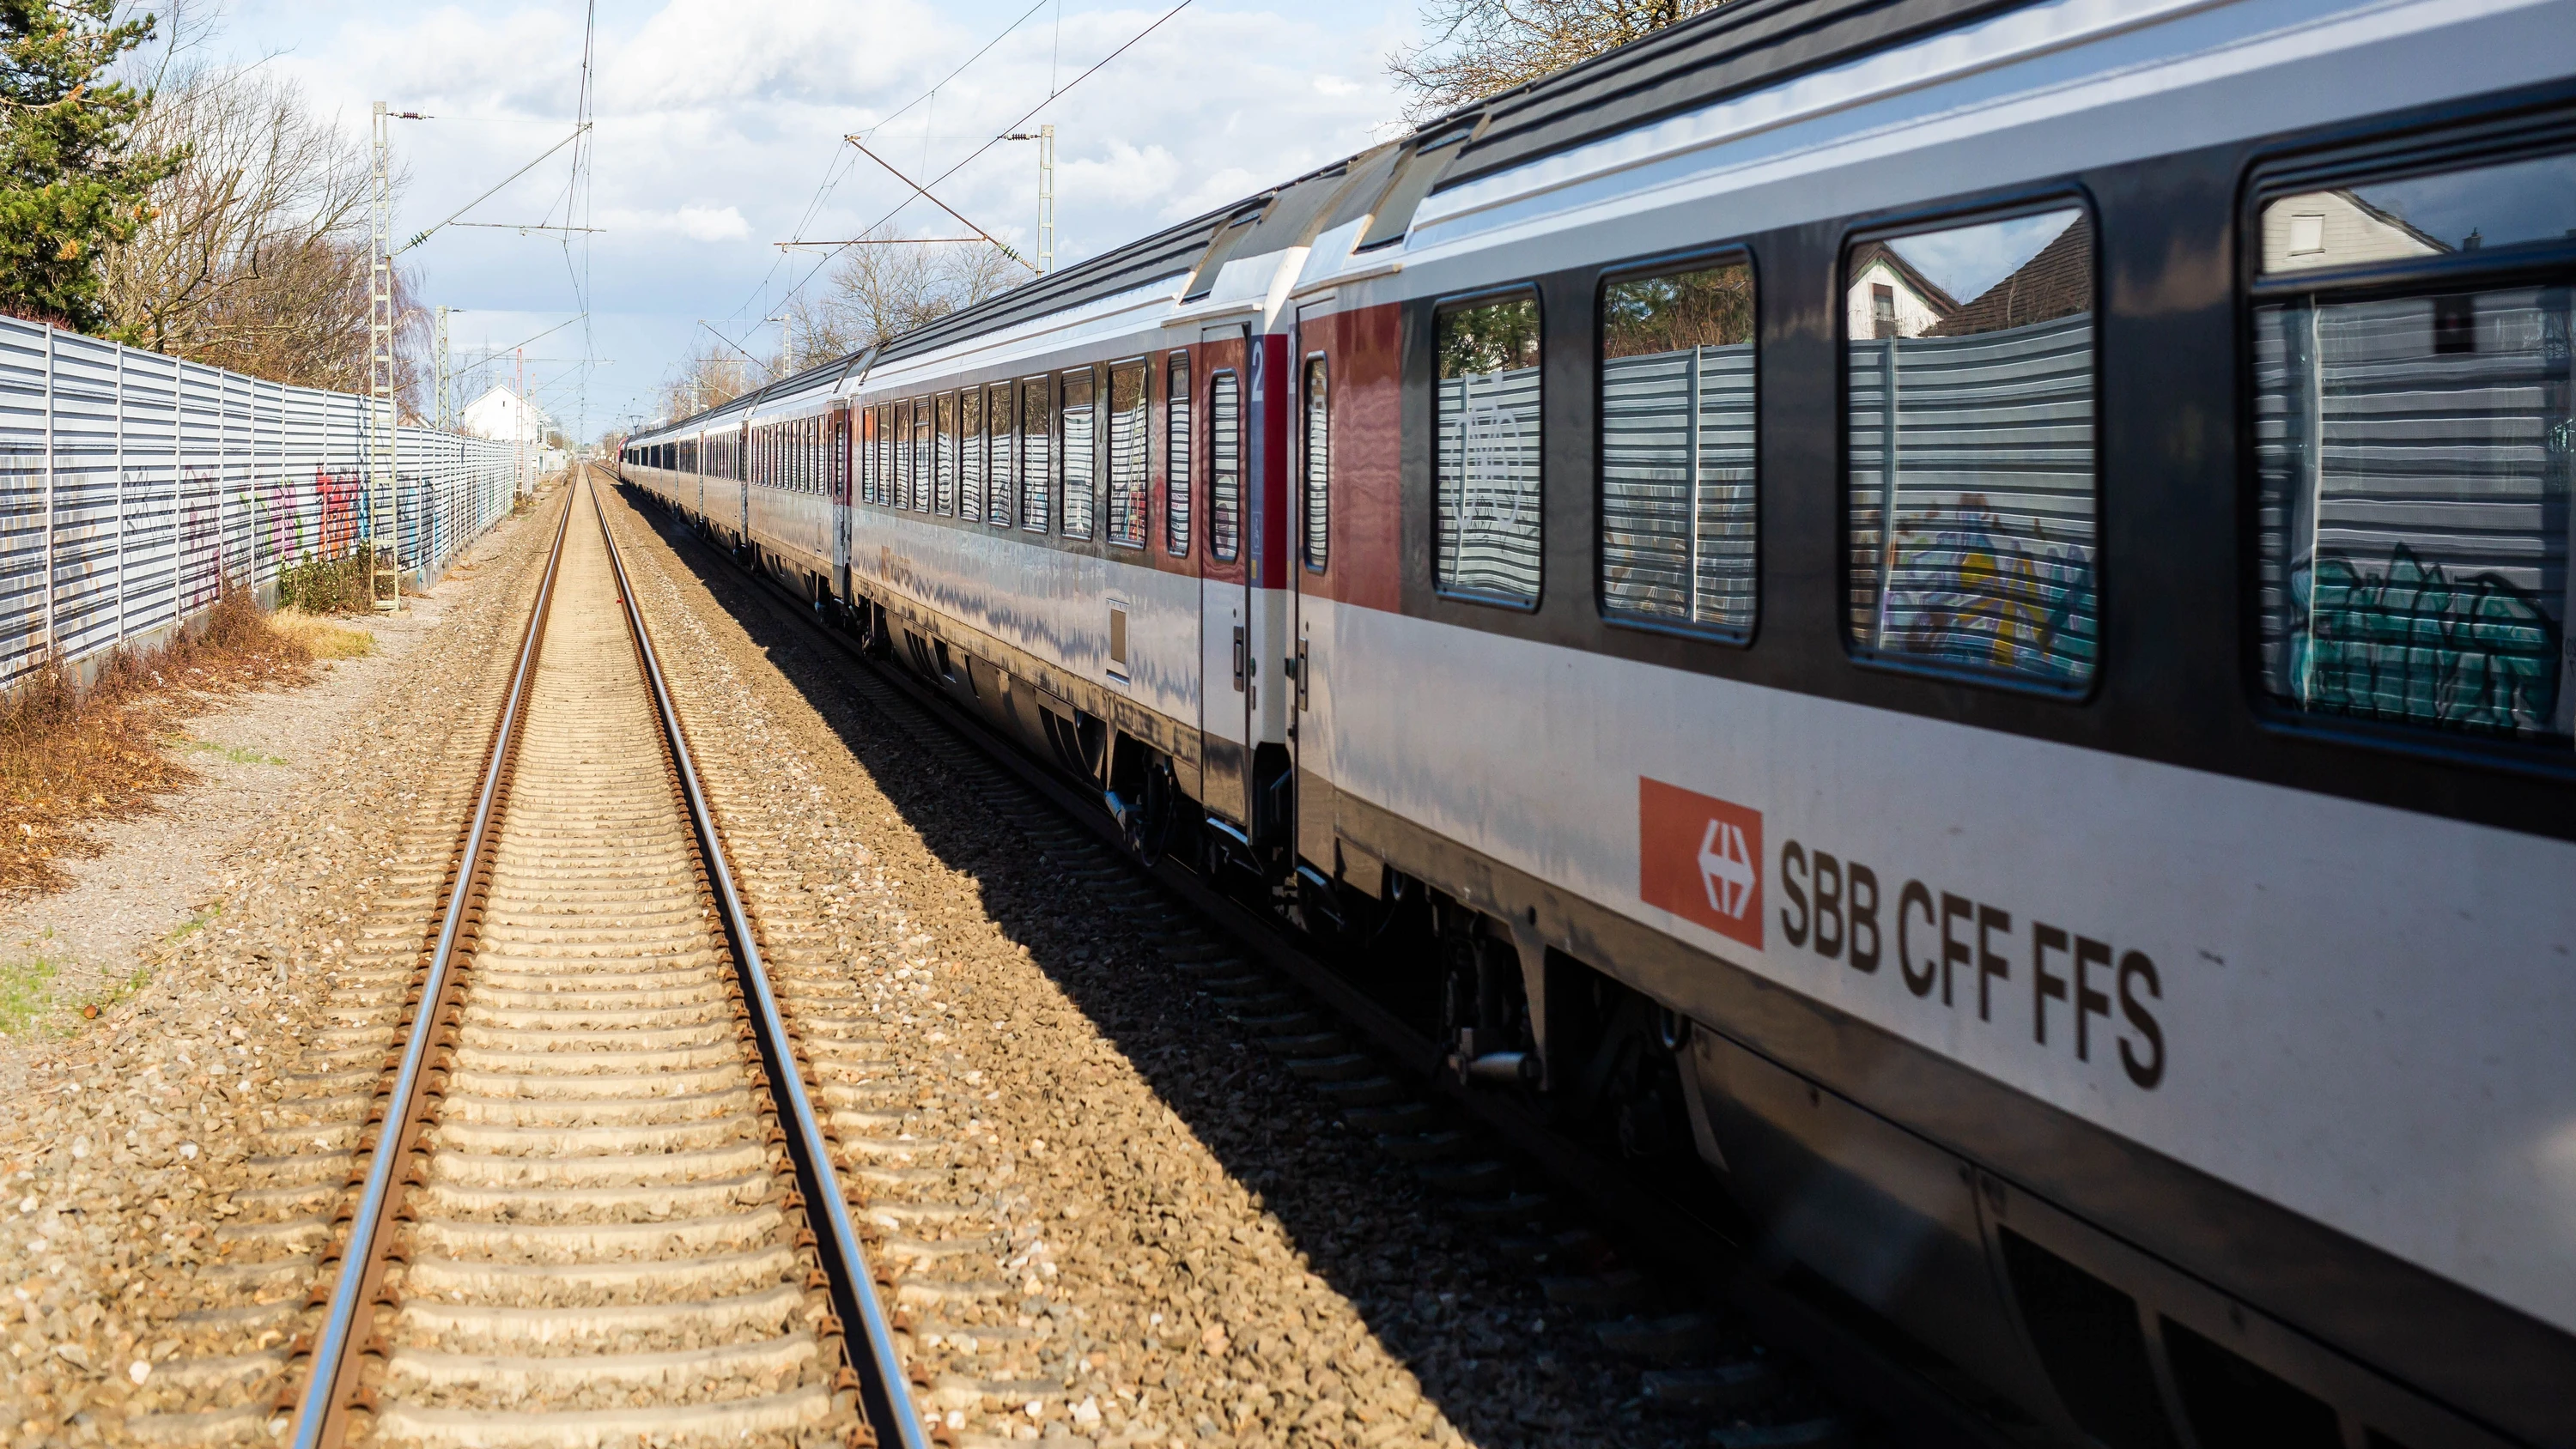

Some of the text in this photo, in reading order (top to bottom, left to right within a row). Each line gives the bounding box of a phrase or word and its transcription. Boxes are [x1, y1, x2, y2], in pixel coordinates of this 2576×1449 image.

[1252, 341, 1263, 402] 2
[1780, 839, 2166, 1090] SBB CFF FFS
